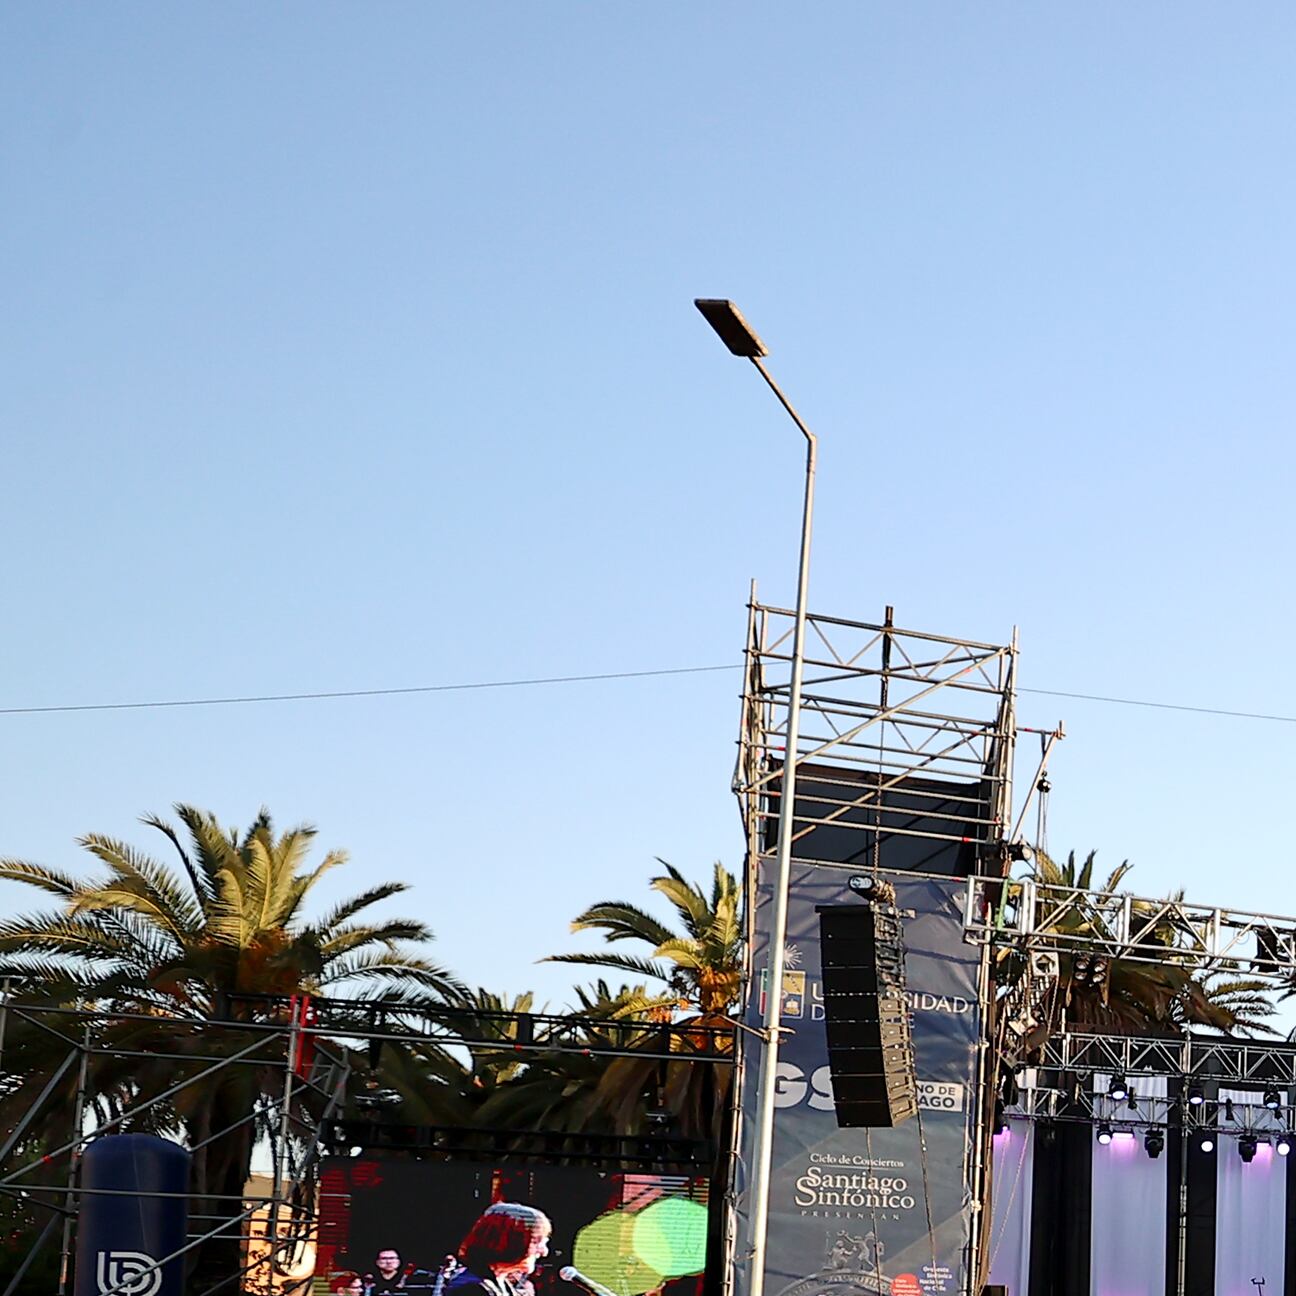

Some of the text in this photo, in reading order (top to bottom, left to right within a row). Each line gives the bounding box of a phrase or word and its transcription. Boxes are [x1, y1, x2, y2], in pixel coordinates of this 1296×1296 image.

[939, 1086, 956, 1096] DE
[810, 1152, 905, 1168] Ciclo de Conciertos
[806, 1166, 907, 1195] Santiago
[795, 1176, 915, 1209] Sinfónico
[801, 1210, 900, 1220] PRESENTAN
